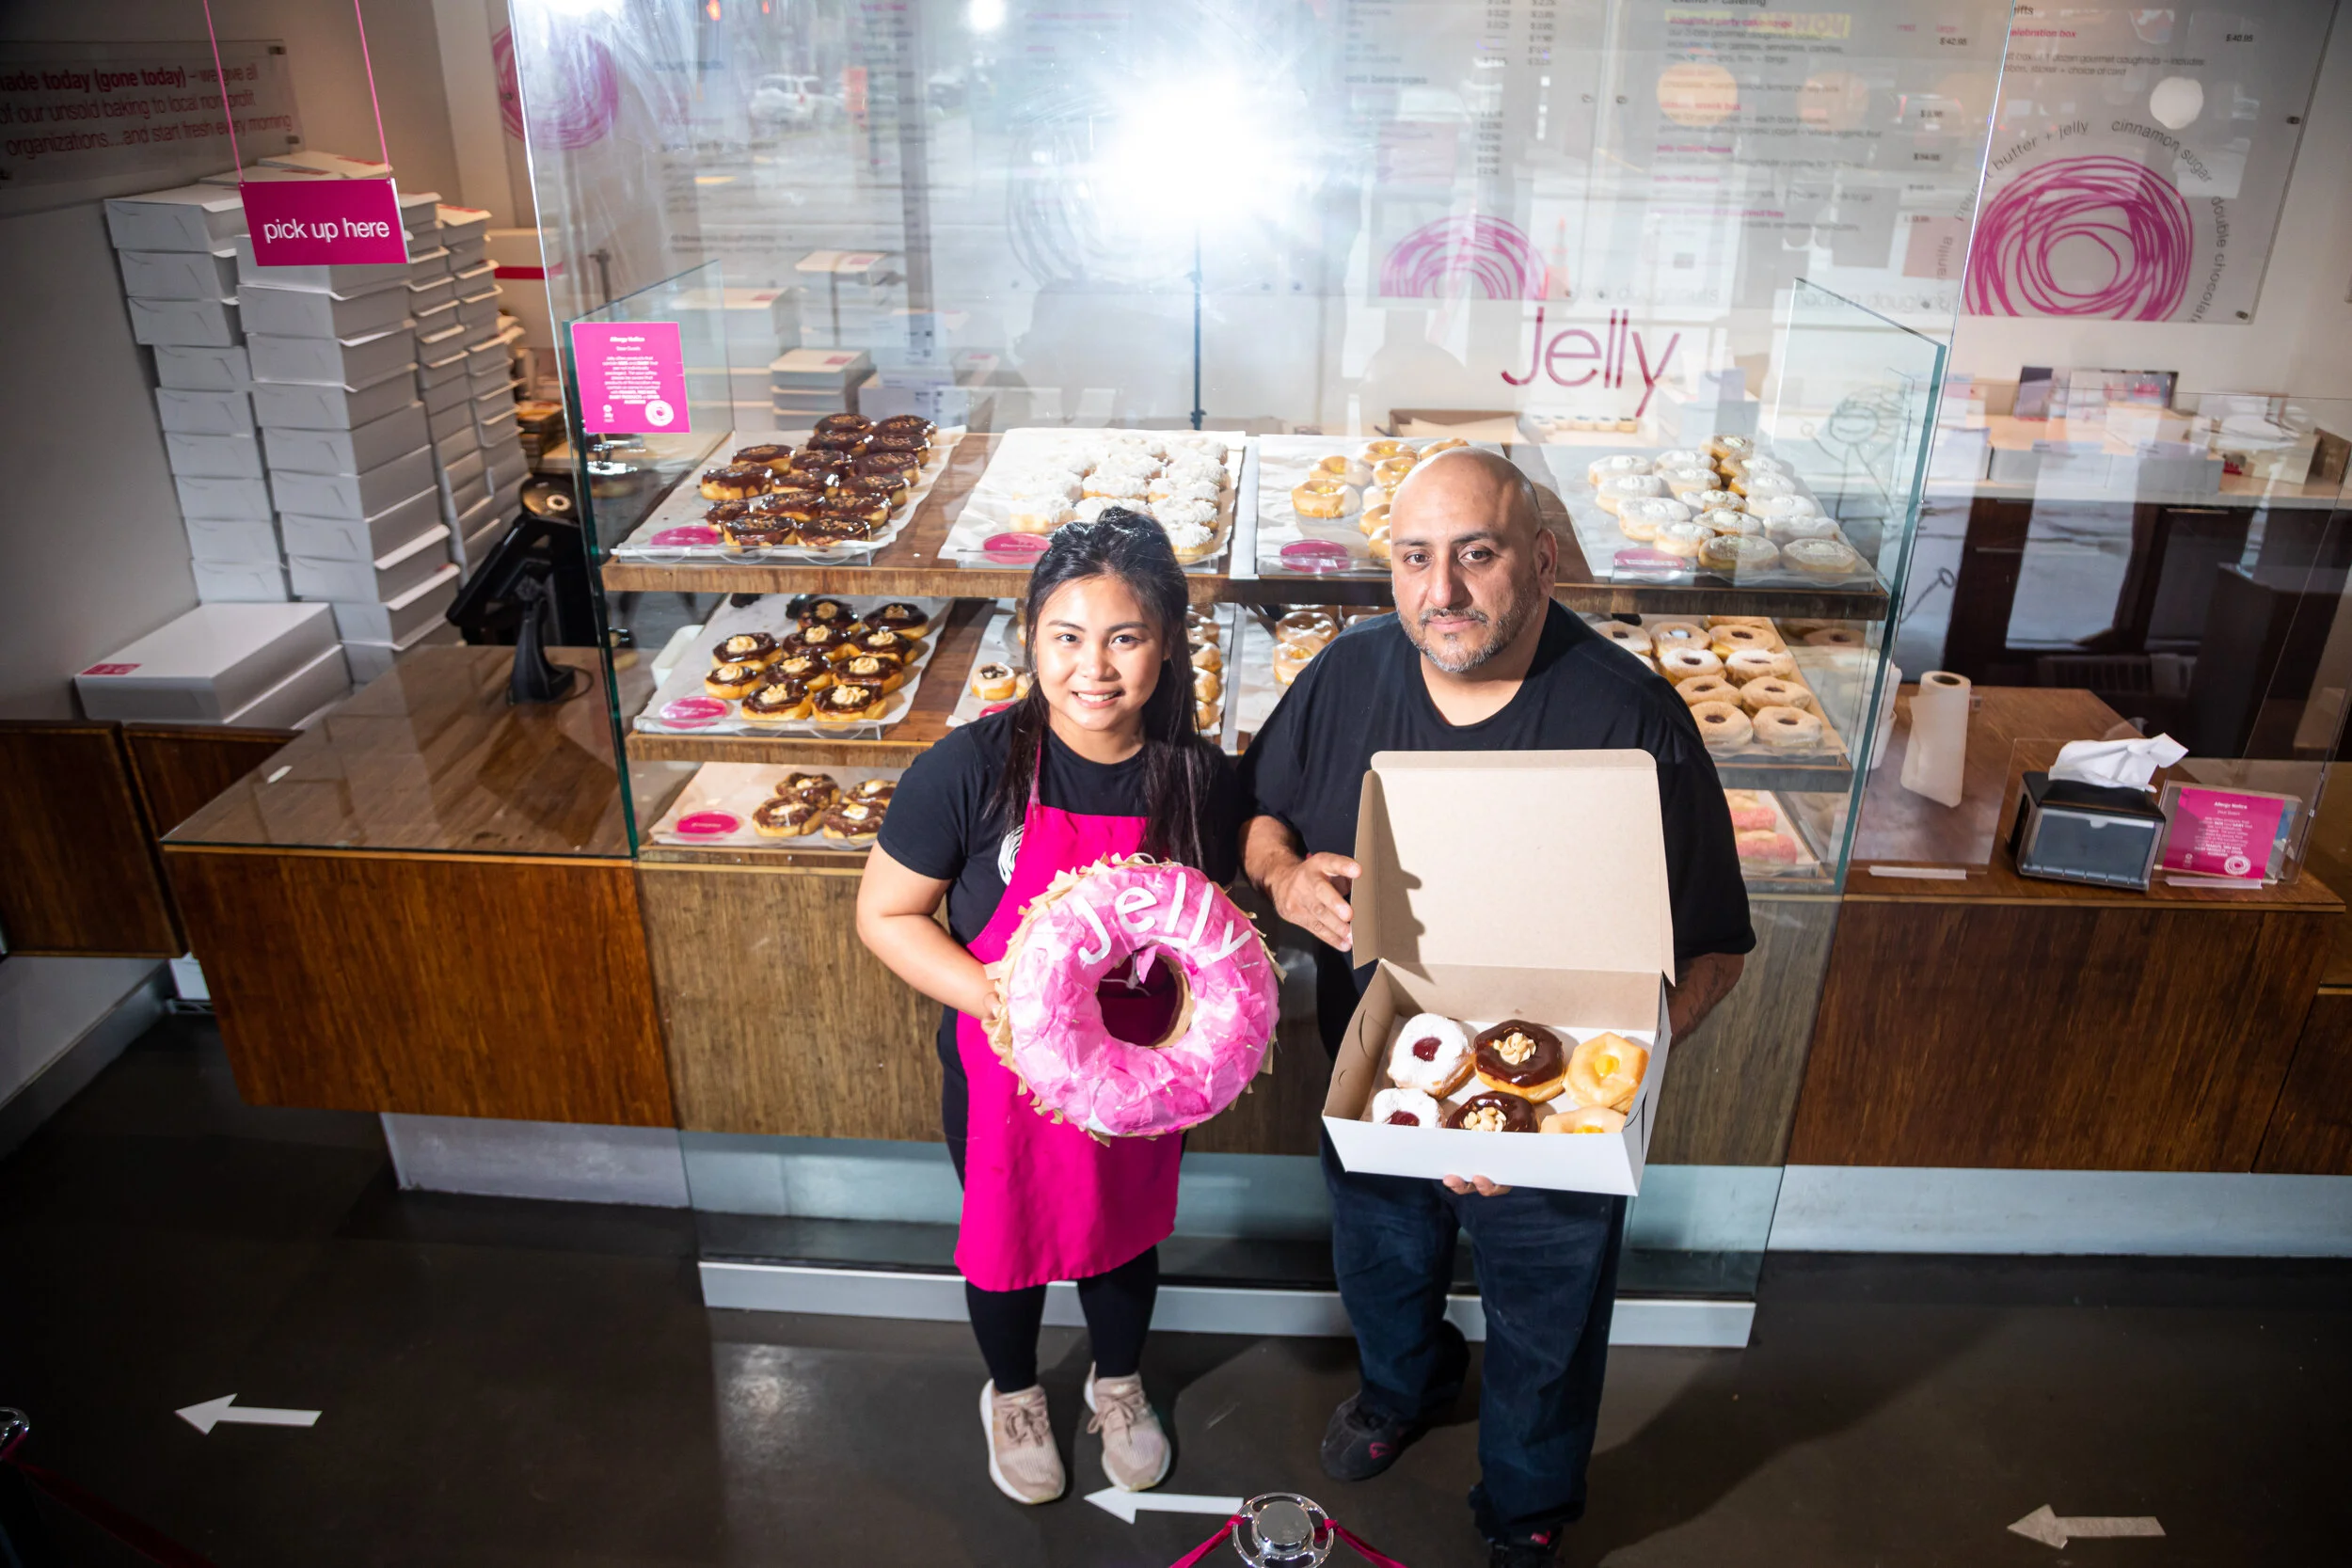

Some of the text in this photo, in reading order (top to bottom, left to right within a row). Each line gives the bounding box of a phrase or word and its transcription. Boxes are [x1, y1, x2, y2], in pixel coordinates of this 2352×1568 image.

[2010, 28, 2058, 39] elebration
[41, 69, 89, 93] today
[94, 68, 138, 93] (gone
[140, 65, 186, 88] today)
[19, 106, 45, 123] our
[49, 99, 100, 120] unsold
[103, 96, 150, 119] baking
[151, 98, 167, 114] to
[168, 94, 199, 112] local
[2059, 119, 2089, 140] jelly
[2111, 119, 2214, 183] cinnamon sugar
[263, 217, 389, 244] pick up here
[2210, 196, 2231, 248] double
[1071, 871, 1252, 966] Jelly
